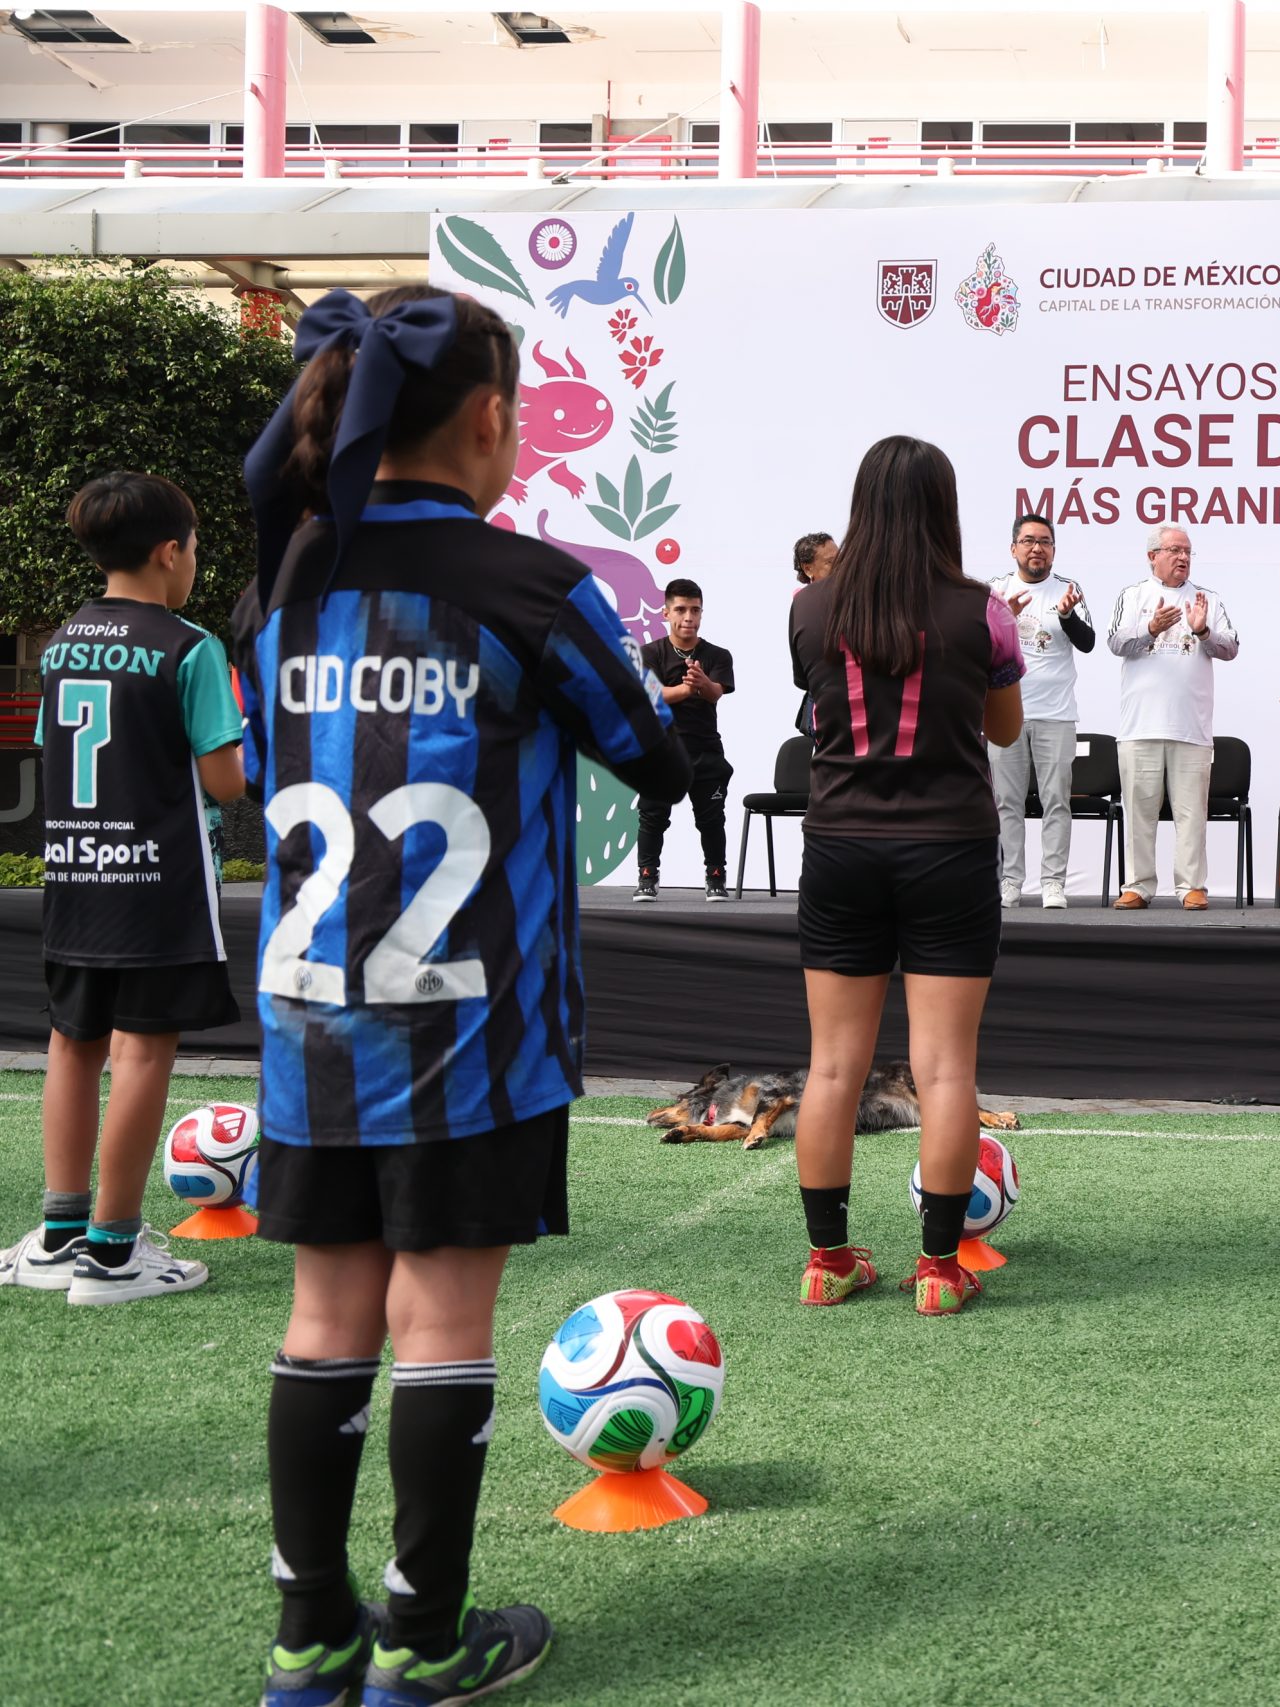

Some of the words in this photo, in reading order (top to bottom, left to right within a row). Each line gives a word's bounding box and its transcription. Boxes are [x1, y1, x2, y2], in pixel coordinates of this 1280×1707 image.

[1040, 267, 1135, 288] CIUDAD
[1144, 266, 1176, 286] DE
[1039, 299, 1096, 312] CAPITAL
[1100, 299, 1119, 311] DE
[1123, 298, 1141, 311] LA
[1063, 362, 1277, 402] ENSAYOS
[1017, 414, 1234, 469] CLASE
[1015, 478, 1121, 525] MÁS
[41, 642, 165, 677] FUSION
[279, 655, 345, 714] CID
[349, 656, 480, 718] COBY
[57, 679, 112, 809] 7
[102, 821, 136, 831] OFICIAL
[79, 836, 160, 872] Sport
[57, 871, 69, 883] DE
[71, 872, 99, 883] ROPA
[101, 871, 161, 883] DEPORTIVA
[259, 781, 491, 1007] 22
